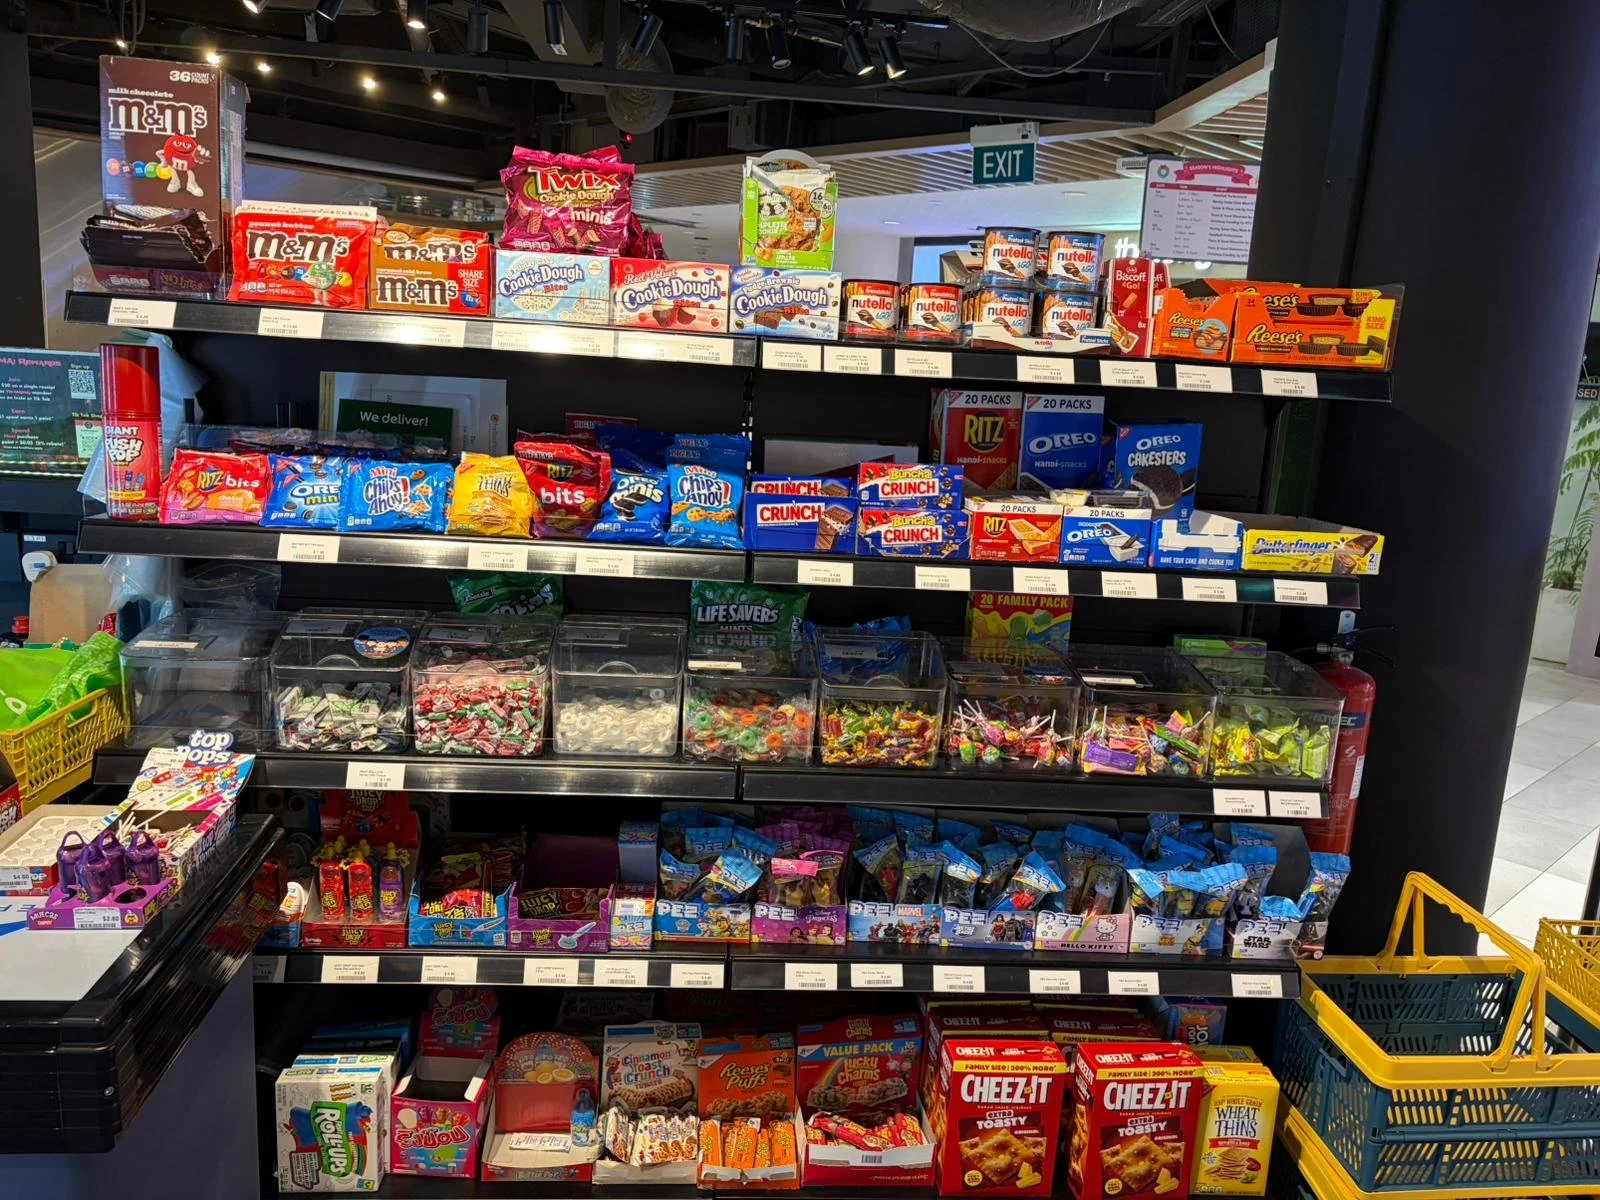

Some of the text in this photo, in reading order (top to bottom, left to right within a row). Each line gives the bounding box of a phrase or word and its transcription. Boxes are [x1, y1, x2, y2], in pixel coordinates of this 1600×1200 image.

[169, 70, 190, 82] 36
[983, 150, 1024, 179] EXIT
[540, 189, 615, 203] Cookie Dough
[813, 192, 823, 200] 16
[570, 207, 613, 225] minis
[992, 246, 1033, 260] nutella
[1057, 250, 1096, 263] nutella
[458, 269, 484, 278] SHARE
[499, 263, 583, 295] Cookie Dough
[623, 266, 678, 285] Red Velvet
[1115, 269, 1147, 281] Biscoff
[463, 278, 480, 287] SIZE
[766, 277, 800, 287] Brownie
[622, 277, 719, 310] Cookie Dough
[736, 286, 828, 313] Cookie Dough
[852, 298, 892, 310] nutella
[916, 301, 956, 313] nutella
[988, 306, 1027, 318] nutella
[1052, 310, 1091, 321] nutella
[1246, 324, 1303, 345] Reese's
[1366, 323, 1386, 331] SIZE
[965, 394, 1011, 405] 20 PACKS
[1043, 399, 1092, 410] 20 PACKS
[360, 411, 429, 427] We deliver!
[104, 426, 139, 436] GIANT
[964, 414, 1005, 444] RITZ
[105, 437, 143, 451] PUSH
[1029, 432, 1097, 453] OREO
[1136, 434, 1181, 450] OREO
[109, 449, 140, 462] POP
[1128, 450, 1186, 467] CAKESTERS
[370, 466, 398, 478] Mini
[547, 463, 575, 480] RITZ
[890, 469, 932, 480] Buncha
[197, 470, 224, 490] RITZ
[225, 474, 260, 488] bits
[678, 474, 723, 497] Chips
[881, 480, 936, 496] CRUNCH
[364, 476, 401, 502] Chips
[541, 487, 586, 505] bits
[753, 480, 819, 497] CRUNCH
[760, 503, 821, 522] CRUNCH
[1001, 505, 1037, 513] 20 PACKS
[1090, 509, 1125, 518] 20 PACKS
[892, 516, 936, 527] Buncha
[983, 516, 1008, 533] RITZ
[883, 527, 939, 543] CRUNCH
[1067, 526, 1112, 543] OREO
[1252, 537, 1332, 556] Butterfinger
[1160, 556, 1172, 564] HAVE
[1173, 556, 1184, 564] YOUR
[1208, 558, 1224, 566] COOKIE
[1368, 553, 1375, 563] 2
[980, 593, 1068, 608] 20 FAMILY PACK
[696, 604, 779, 623] LIFE SAVERS
[190, 729, 230, 750] top
[177, 745, 231, 765] pops
[521, 890, 560, 909] JUICY
[657, 900, 700, 918] PEZ
[754, 903, 797, 921] PEZ
[849, 902, 891, 918] PEZ
[897, 906, 923, 917] MARVEL
[945, 910, 986, 925] PEZ
[1042, 910, 1084, 928] PEZ
[1137, 914, 1183, 931] PEZ
[1239, 919, 1286, 935] PEZ
[1243, 940, 1271, 949] WARS
[822, 1042, 894, 1057] VALUE PACK
[621, 1051, 671, 1065] Cinnamon
[631, 1060, 662, 1072] Toast
[844, 1056, 879, 1072] Lucky
[1095, 1053, 1134, 1063] CHEEZ-IT
[624, 1068, 670, 1084] Crunch
[727, 1074, 768, 1091] Puffs
[838, 1069, 881, 1084] Charms
[960, 1073, 1053, 1105] CHEEZ-IT
[1103, 1080, 1192, 1112] CHEEZ-IT
[1216, 1106, 1260, 1121] WHEAT
